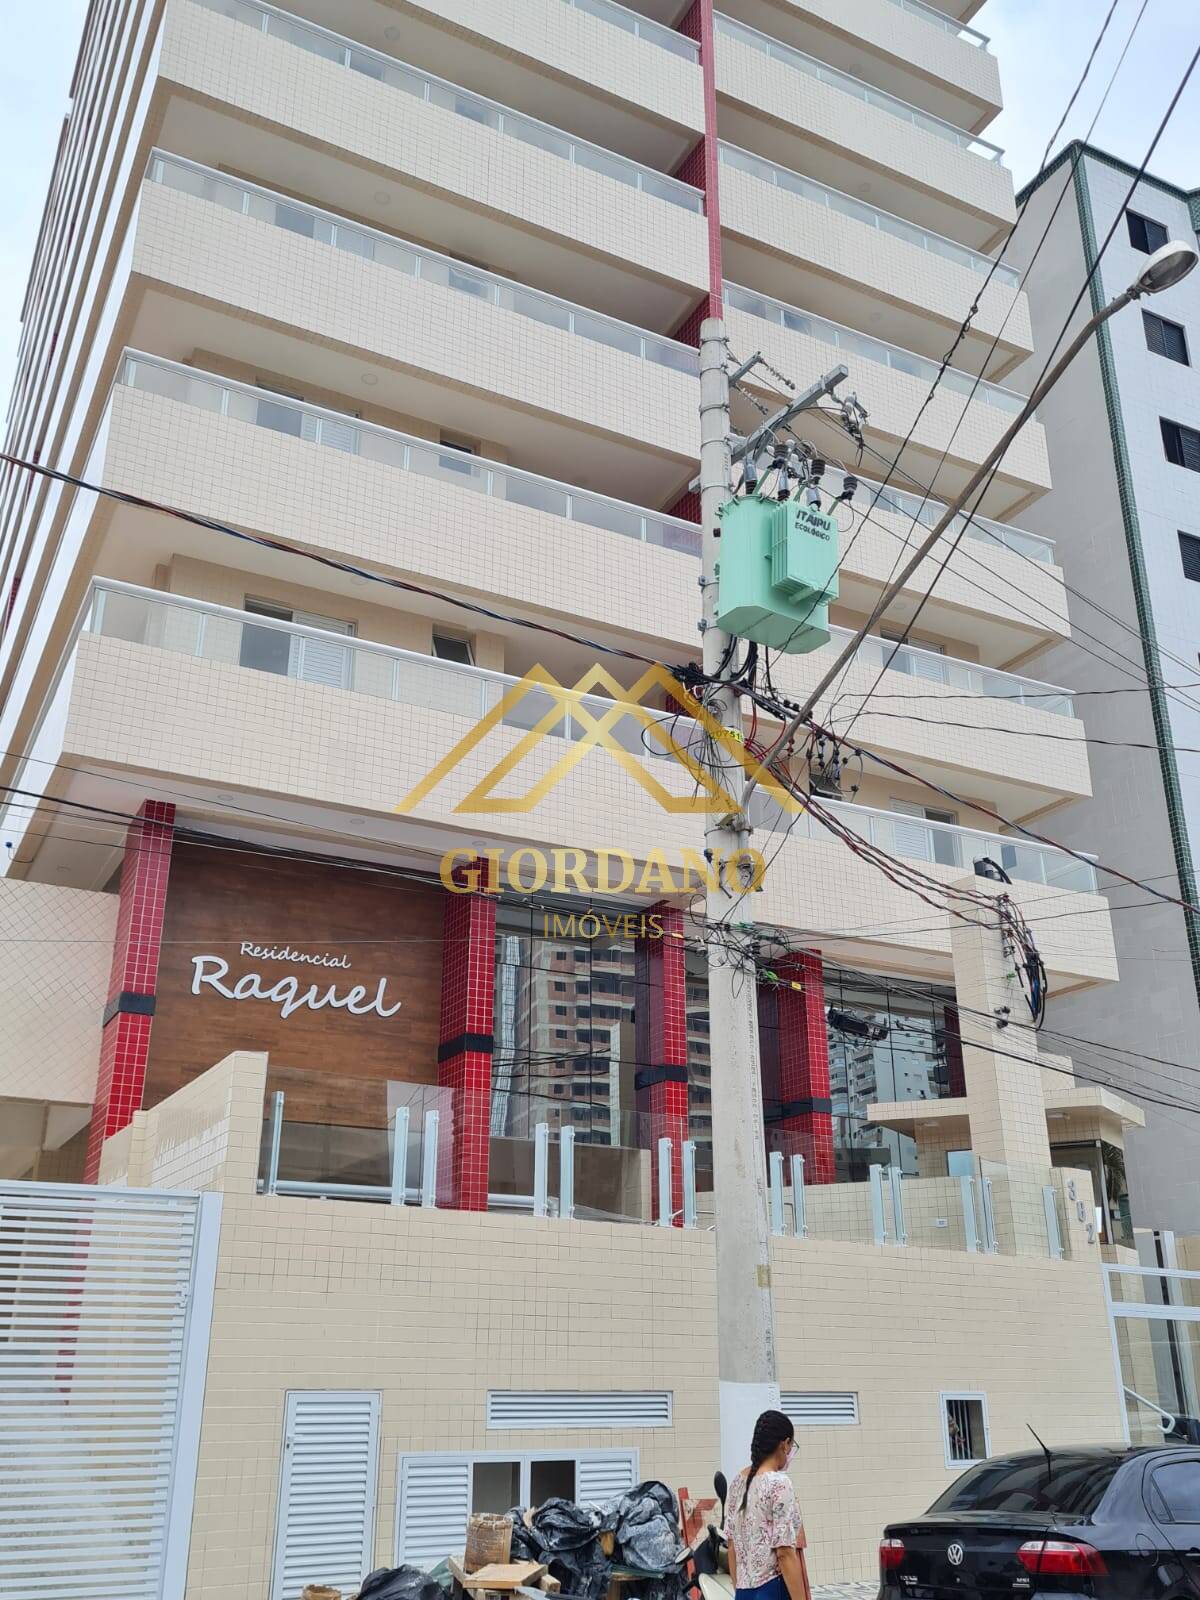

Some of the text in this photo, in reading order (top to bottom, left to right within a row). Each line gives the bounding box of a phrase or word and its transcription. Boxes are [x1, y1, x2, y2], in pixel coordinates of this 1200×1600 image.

[796, 510, 831, 531] ITAIPU
[240, 942, 352, 969] Residencial
[191, 955, 402, 1018] Raquel
